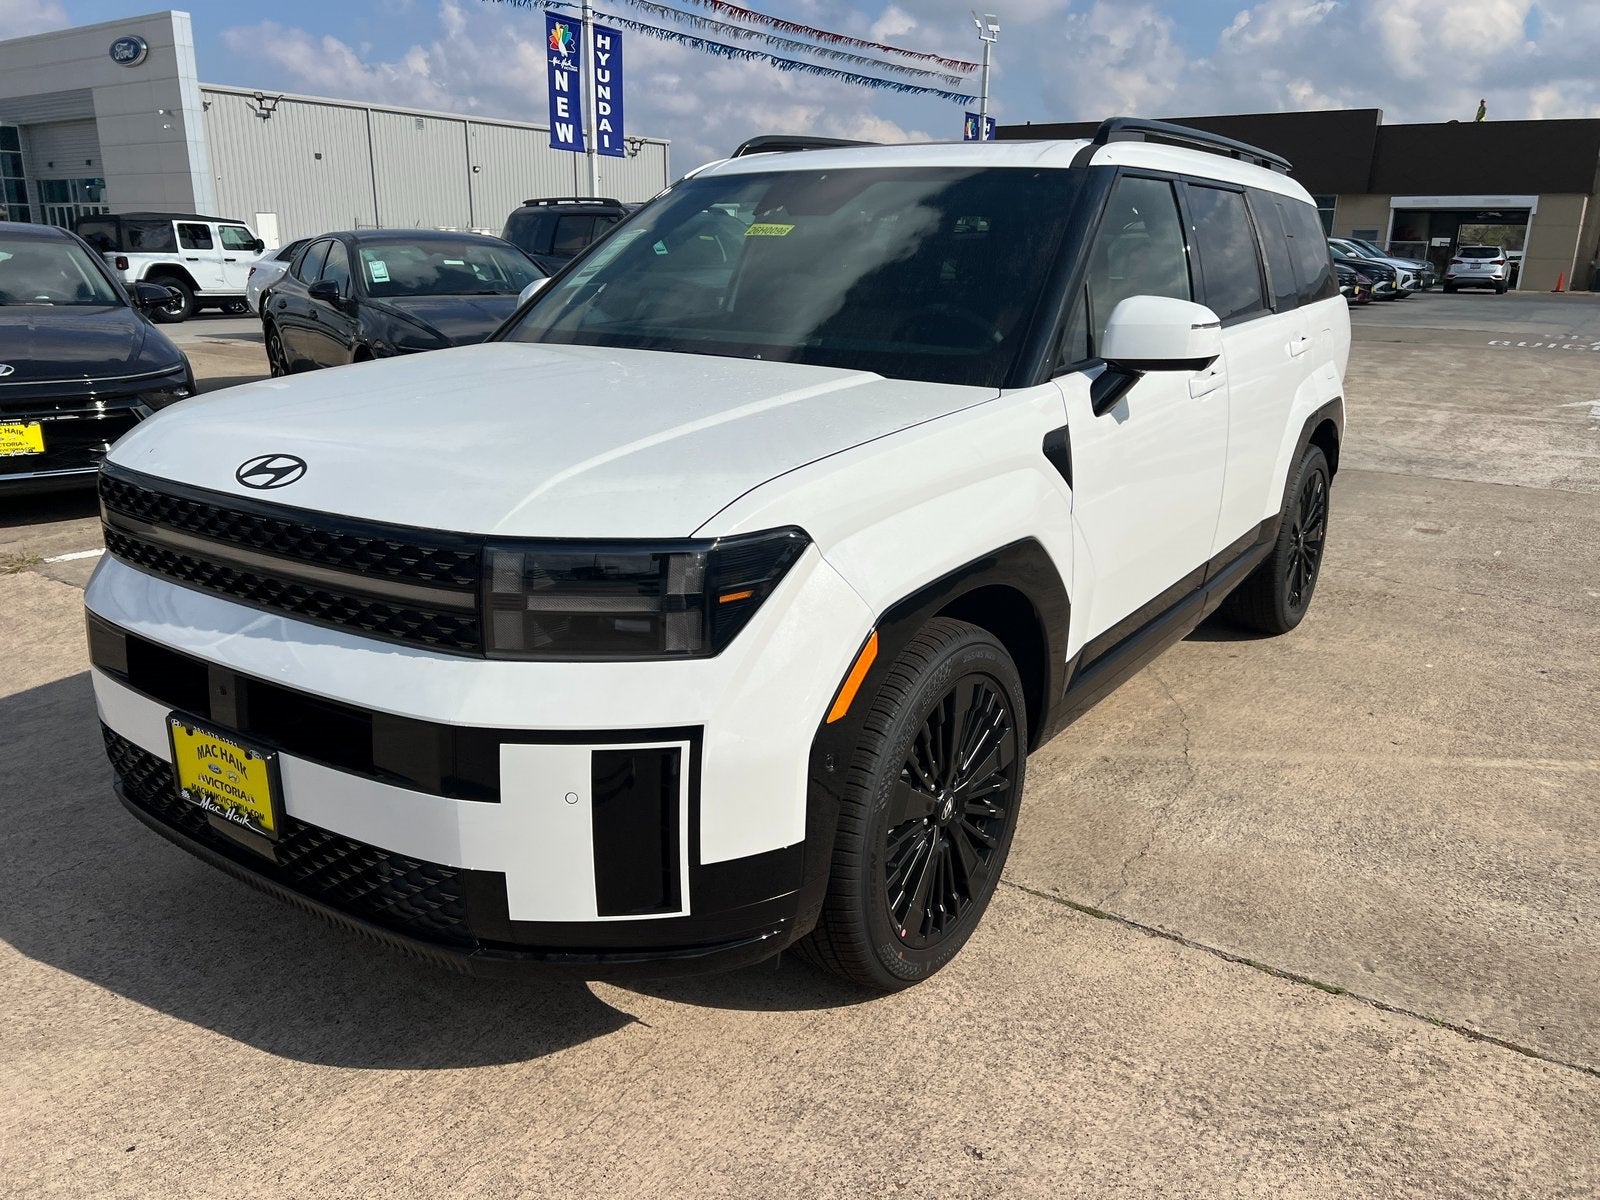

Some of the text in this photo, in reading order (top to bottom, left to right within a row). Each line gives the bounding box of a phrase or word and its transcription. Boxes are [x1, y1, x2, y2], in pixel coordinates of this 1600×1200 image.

[114, 42, 134, 60] Ford
[596, 34, 613, 148] HYUNDAI
[554, 69, 574, 144] NEW
[4, 428, 24, 437] HAIK
[197, 744, 249, 780] MAC HAIK
[204, 775, 248, 801] VICTORIA
[199, 795, 224, 816] Mac
